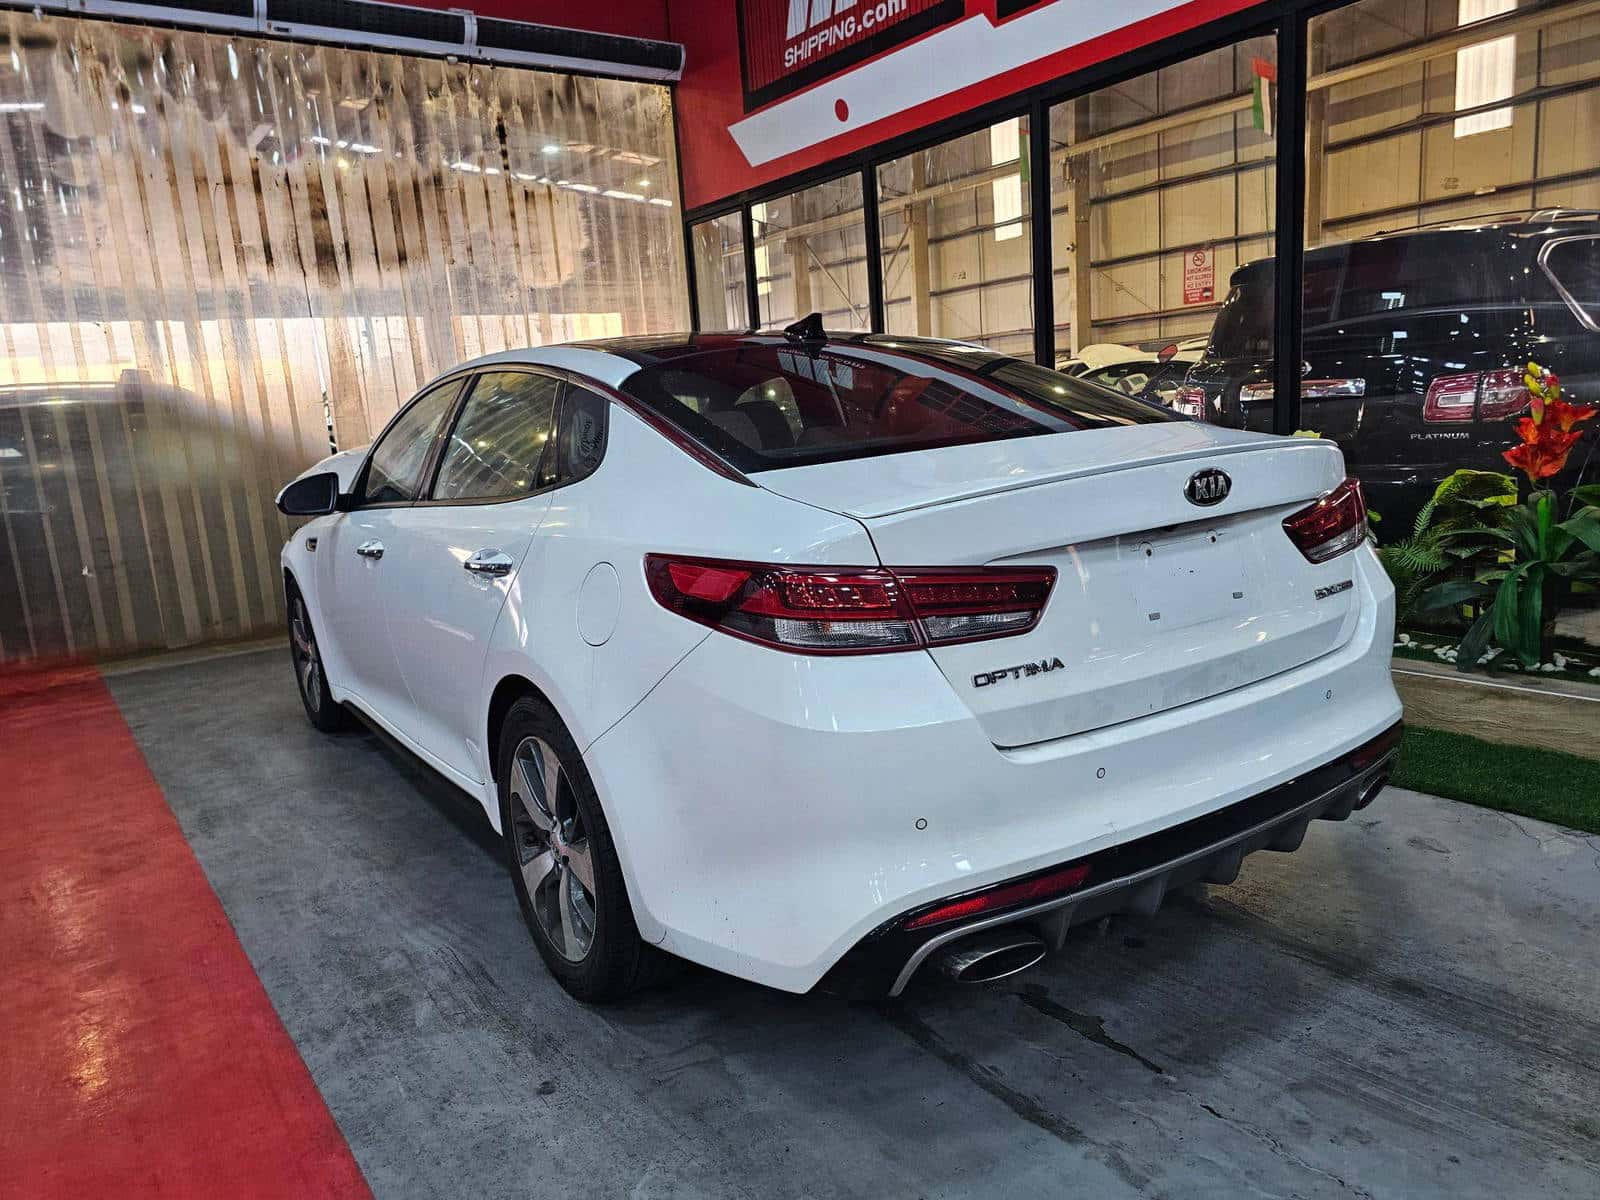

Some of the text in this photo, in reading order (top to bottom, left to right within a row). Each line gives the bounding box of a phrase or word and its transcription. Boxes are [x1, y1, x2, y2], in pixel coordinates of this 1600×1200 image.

[784, 0, 907, 68] SHIPPING.com
[1409, 432, 1471, 441] PLATINUM
[1192, 474, 1228, 500] KIA
[972, 656, 1065, 688] OPTIMA
